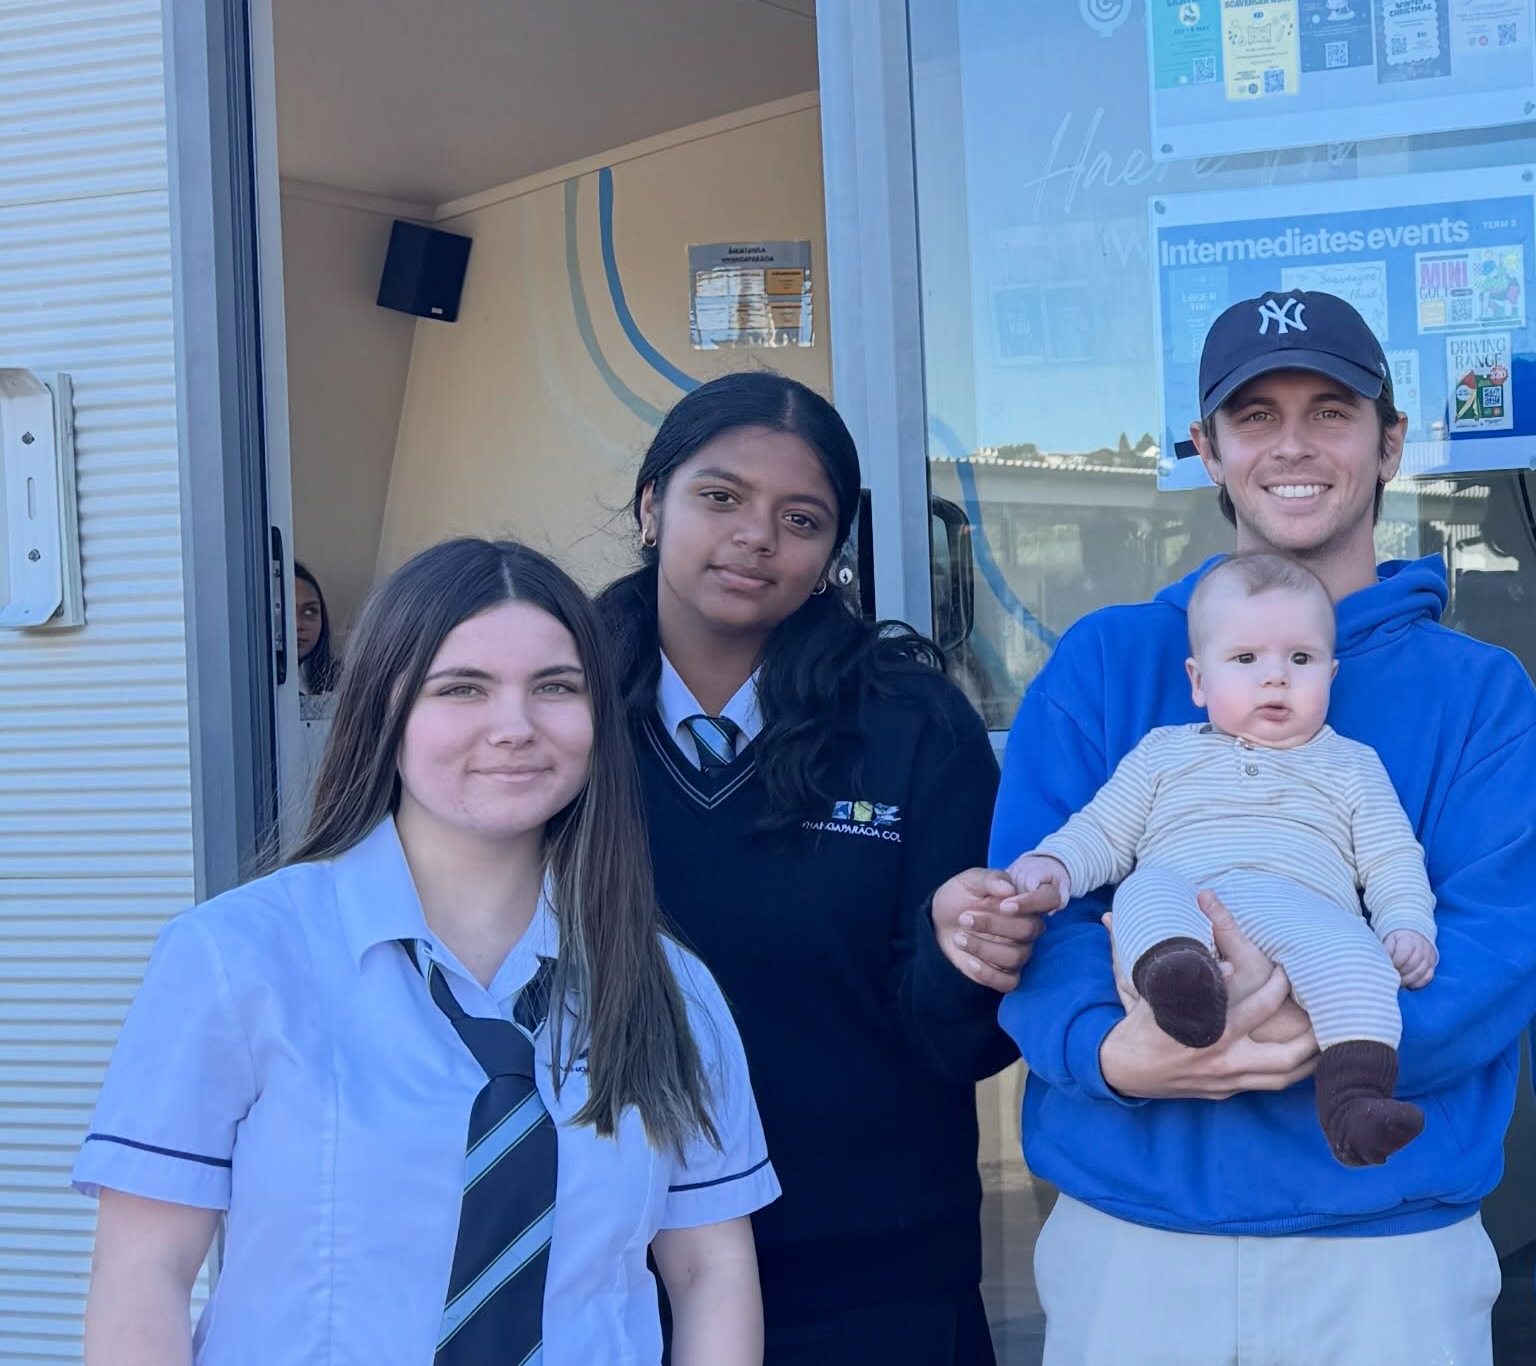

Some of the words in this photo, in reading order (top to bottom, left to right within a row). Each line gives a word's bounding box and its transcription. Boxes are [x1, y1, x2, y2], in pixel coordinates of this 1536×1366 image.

[1482, 221, 1507, 229] TERM
[1509, 220, 1517, 228] 2
[1161, 227, 1364, 267] Intermediates
[1367, 217, 1470, 250] events
[1420, 261, 1468, 289] MINI
[1182, 291, 1217, 303] LASER
[1258, 297, 1308, 335] NY
[1450, 337, 1506, 356] DRIVING
[1455, 353, 1502, 369] RANGE
